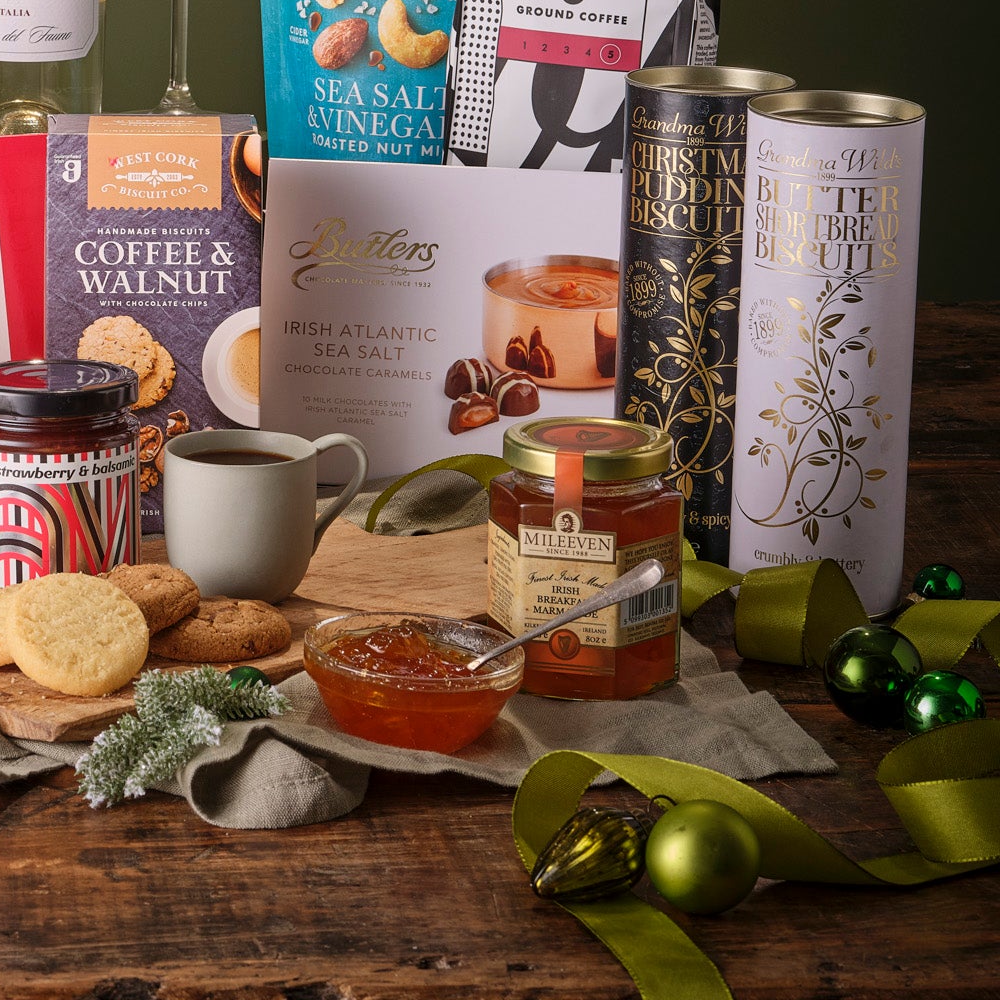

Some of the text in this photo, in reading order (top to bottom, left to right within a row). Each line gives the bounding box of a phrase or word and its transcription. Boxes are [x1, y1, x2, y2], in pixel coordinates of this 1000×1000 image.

[516, 5, 628, 25] GROUND COFFEE
[1, 29, 26, 42] del
[29, 25, 73, 44] Fauno
[289, 25, 308, 37] CIDER
[289, 35, 309, 45] VINEGAR
[314, 77, 446, 111] SEA SALT
[631, 106, 705, 136] Grandma
[312, 133, 443, 157] ROASTED NUT MI
[686, 136, 705, 146] 1899
[113, 151, 200, 170] WEST CORK
[756, 139, 836, 171] Grandma
[631, 167, 746, 204] PUDDIN
[816, 172, 836, 182] 1899
[119, 185, 168, 199] BISCUIT
[756, 175, 899, 213] BUTTER
[630, 195, 745, 233] BISCUIT
[755, 203, 899, 243] SHORTBREAD
[74, 240, 236, 266] COFFEE &
[288, 216, 439, 275] Butlers
[755, 231, 900, 271] BISCUITS
[76, 269, 233, 295] WALNUT
[629, 279, 657, 302] 1899
[283, 320, 437, 343] IRISH ATLANTIC
[314, 343, 406, 361] SEA SALT
[284, 363, 432, 381] CHOCOLATE CARAMELS
[305, 405, 326, 413] IRISH
[328, 407, 367, 416] ATLANTIC
[388, 410, 408, 418] SALT
[313, 396, 412, 409] MILK CHOCOLATES WITH
[336, 417, 375, 425] CARAMEL
[78, 465, 89, 477] &
[91, 455, 135, 476] balsamic
[689, 510, 731, 530] & spicy
[523, 531, 612, 552] MILEEVEN
[546, 547, 569, 556] SINCE
[537, 594, 582, 606] BREAKFA
[551, 585, 580, 595] IRISH
[533, 605, 599, 619] MARMDE
[582, 627, 607, 635] IRELAND
